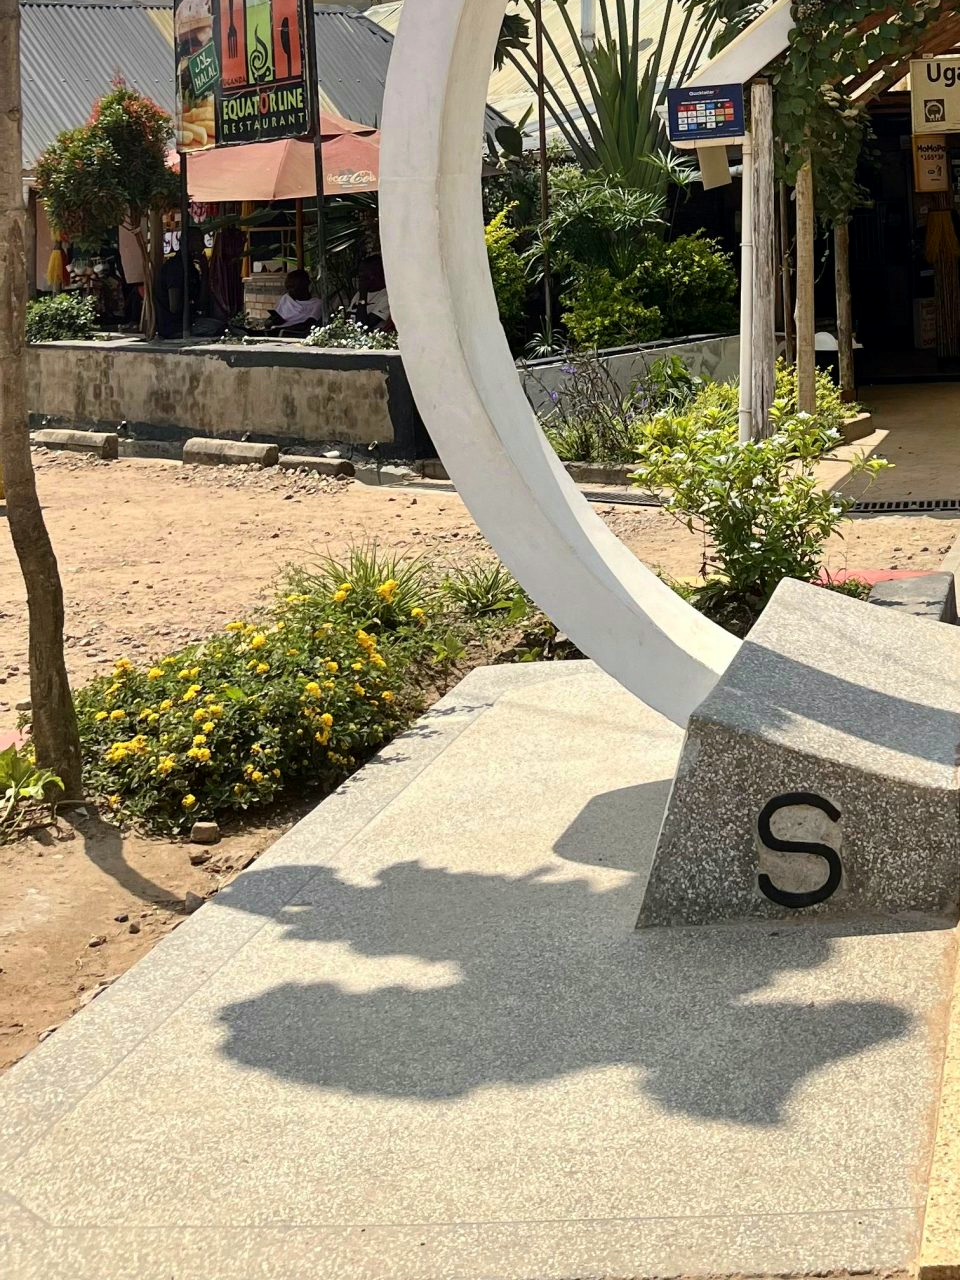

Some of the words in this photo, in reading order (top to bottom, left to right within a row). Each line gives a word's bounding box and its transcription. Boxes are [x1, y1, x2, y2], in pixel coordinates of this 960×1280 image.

[194, 63, 218, 89] HALAL
[223, 113, 304, 135] RESTAURANT
[757, 792, 843, 909] S
